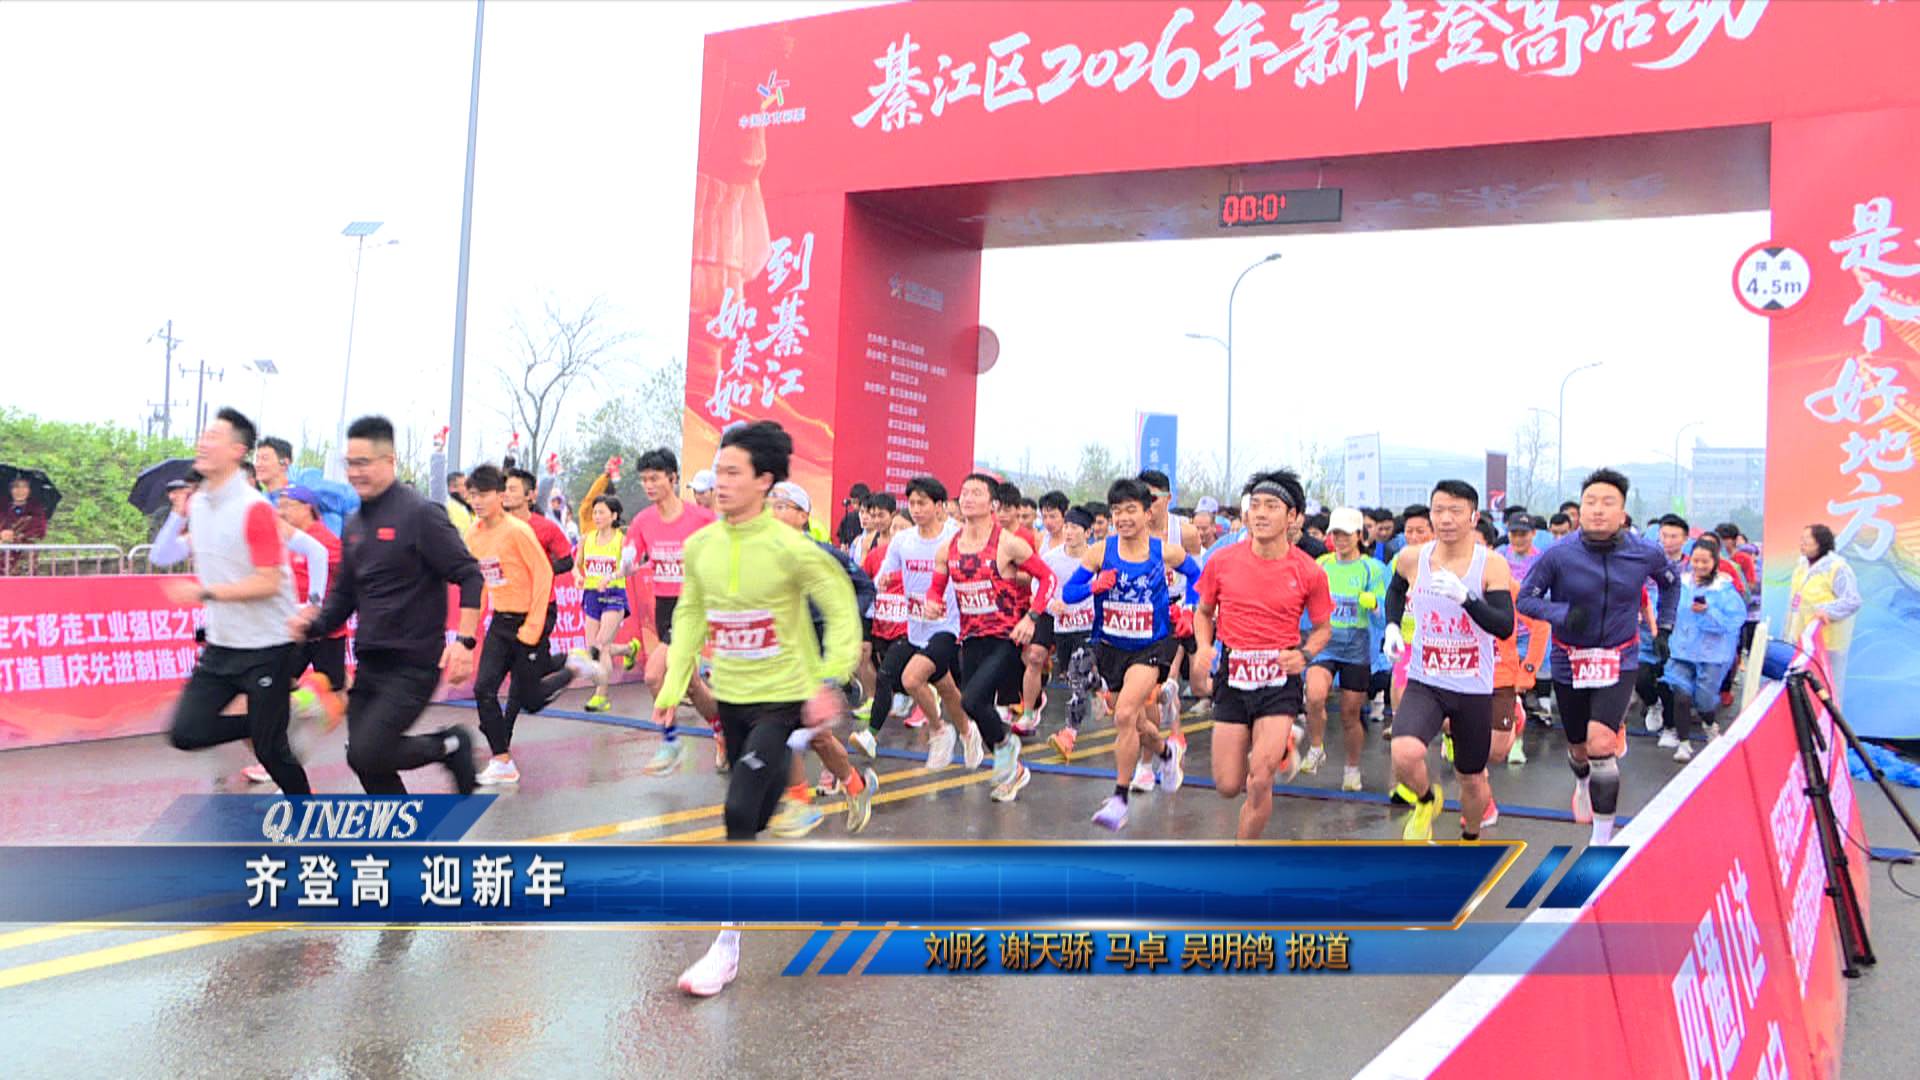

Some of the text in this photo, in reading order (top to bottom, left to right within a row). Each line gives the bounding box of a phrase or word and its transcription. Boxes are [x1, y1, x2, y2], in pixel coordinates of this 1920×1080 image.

[852, 1, 1768, 132] 綦江区2026年新年登高活动
[1746, 277, 1802, 295] 4.5m
[754, 232, 814, 407] 到綦江
[705, 287, 757, 432] 如来如
[1804, 197, 1920, 561] 是个好地方
[0, 646, 204, 693] 打造重庆先进制造业
[1234, 663, 1280, 682] A109
[1427, 651, 1473, 671] A327
[1578, 663, 1611, 680] A051
